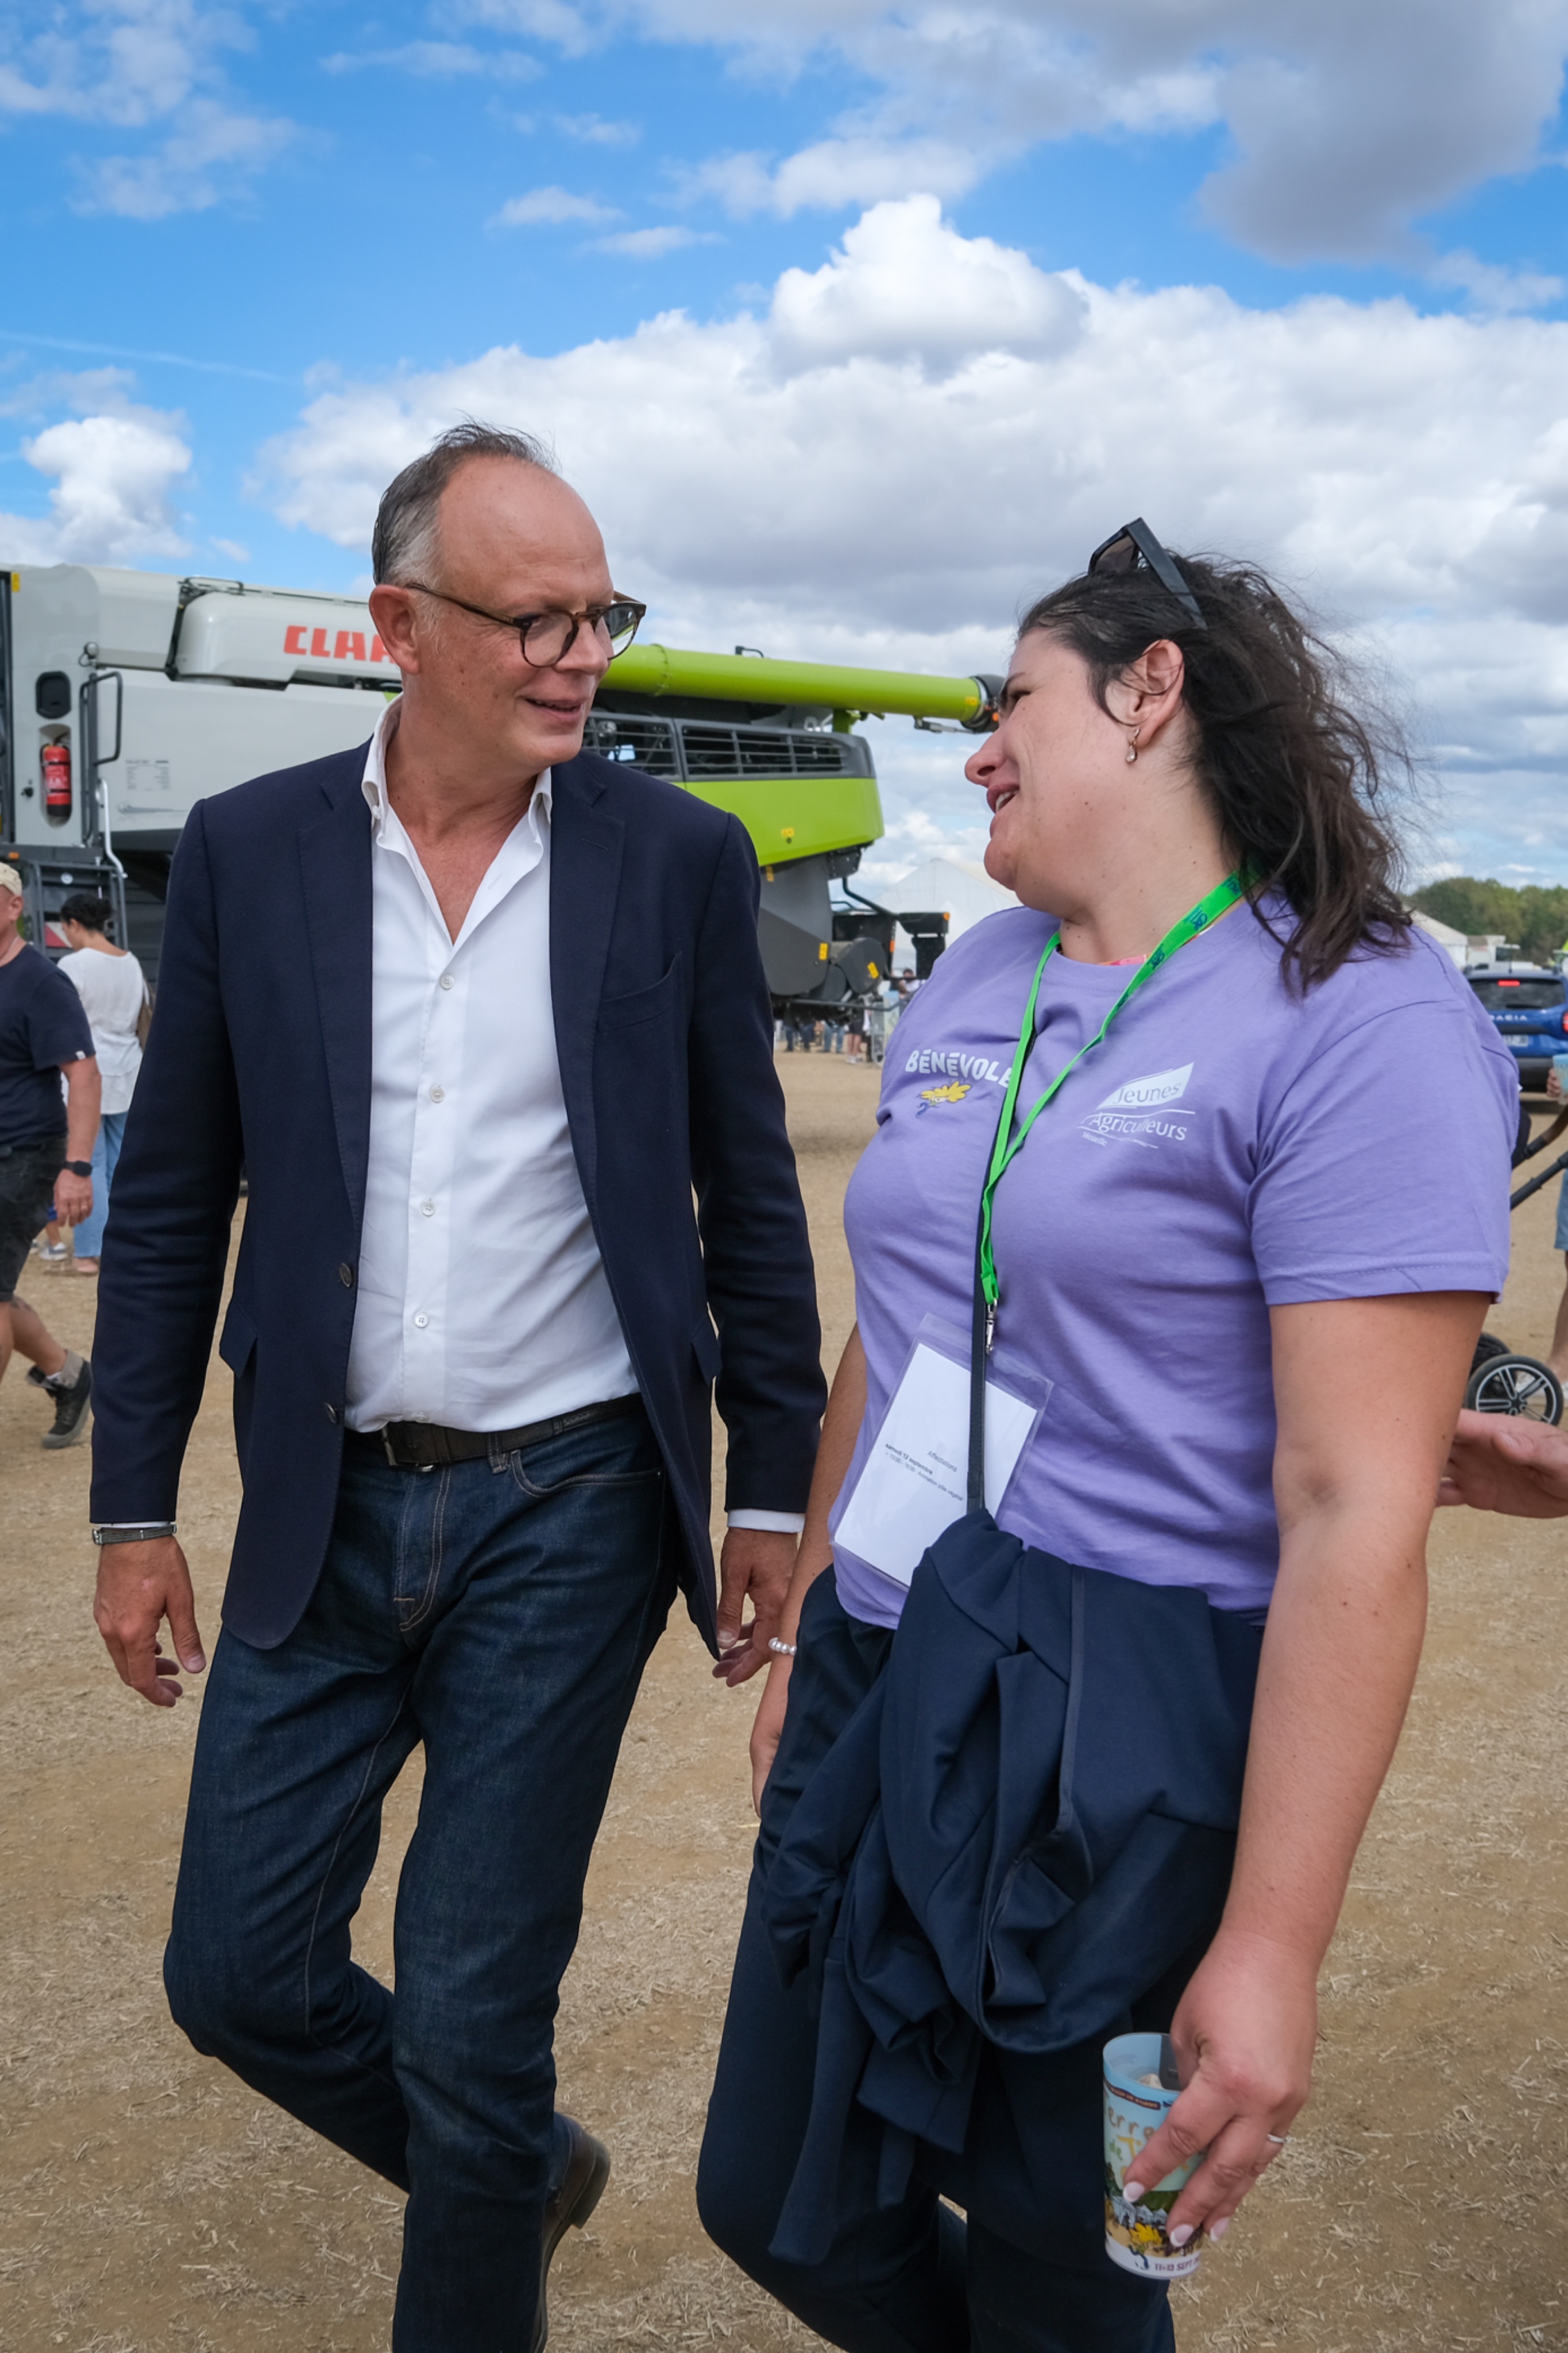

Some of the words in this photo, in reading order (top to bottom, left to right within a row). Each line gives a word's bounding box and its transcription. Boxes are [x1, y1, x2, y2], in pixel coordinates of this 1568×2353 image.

[1113, 1083, 1181, 1104] Jeunes
[886, 1444, 902, 1456] samedi
[909, 1458, 933, 1475] septembre
[927, 1451, 957, 1472] Affectations
